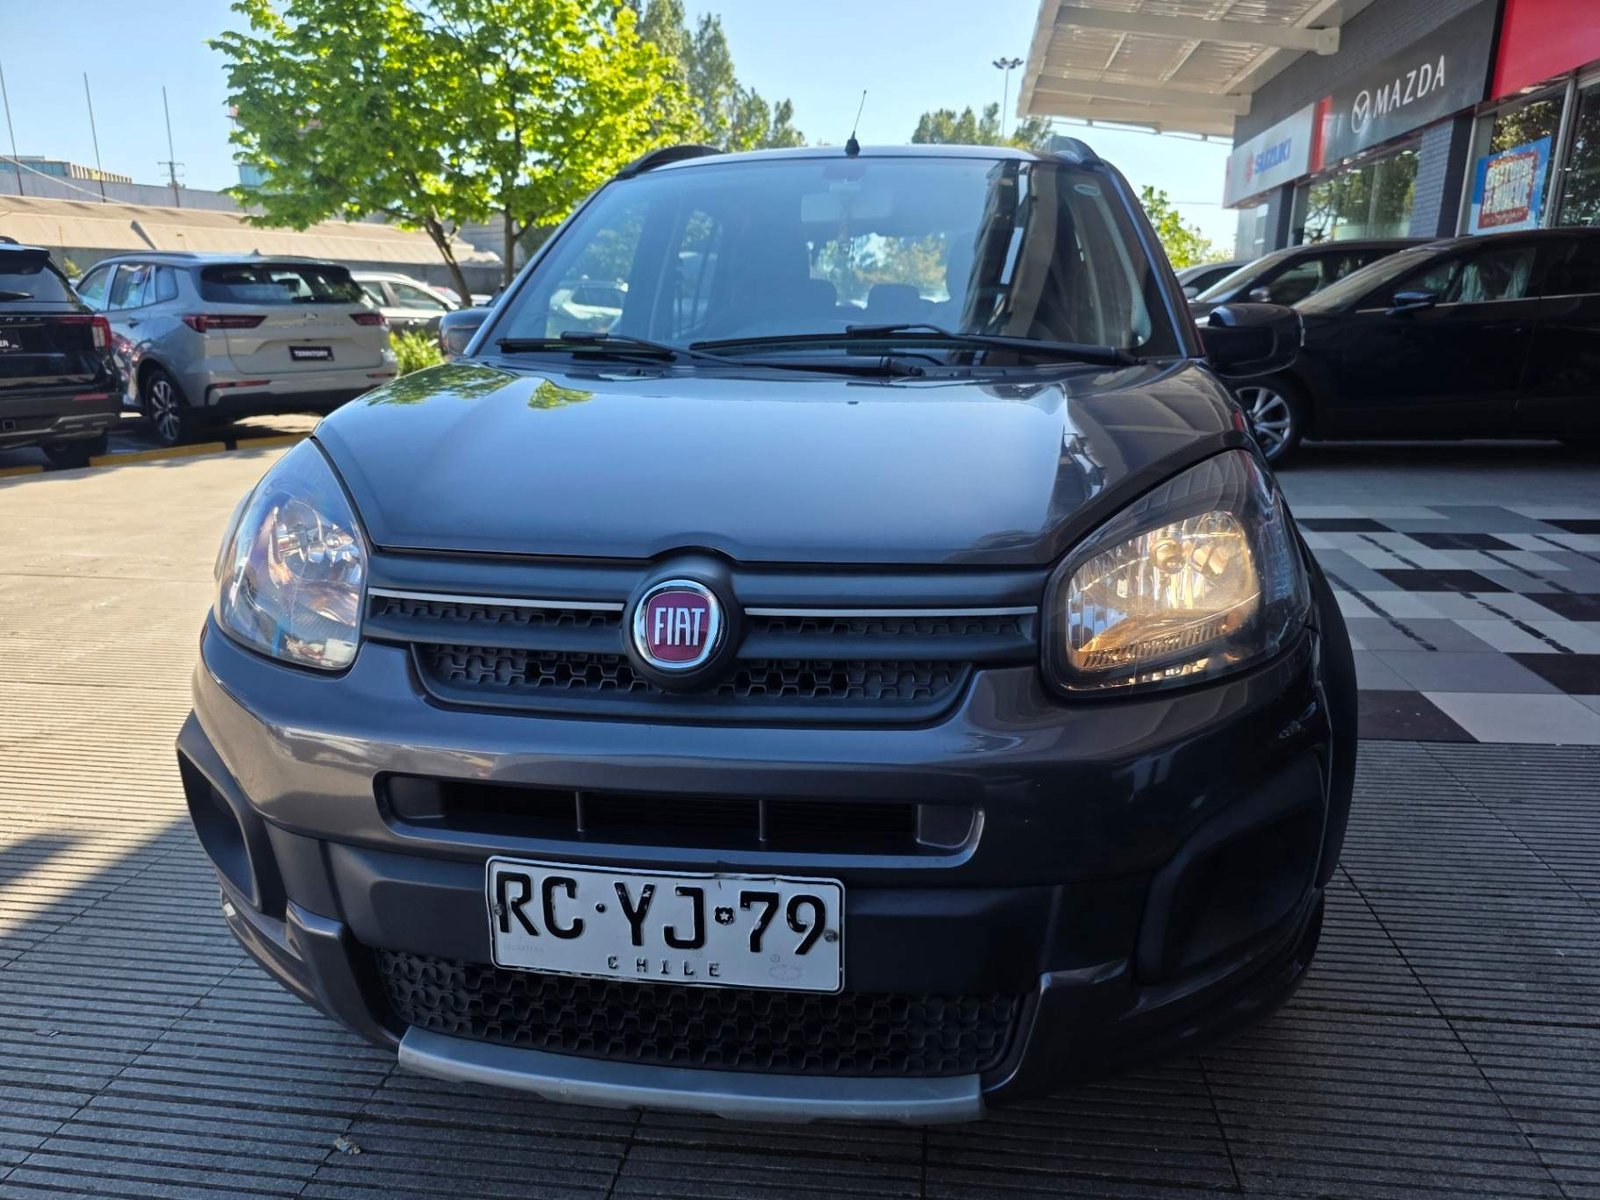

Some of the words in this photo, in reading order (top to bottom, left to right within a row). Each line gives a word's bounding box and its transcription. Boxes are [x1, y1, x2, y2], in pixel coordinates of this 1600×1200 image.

[1373, 54, 1445, 118] MAZDA
[1255, 138, 1292, 174] SUZUKI
[654, 606, 706, 646] FIAT
[607, 954, 721, 978] CHILE
